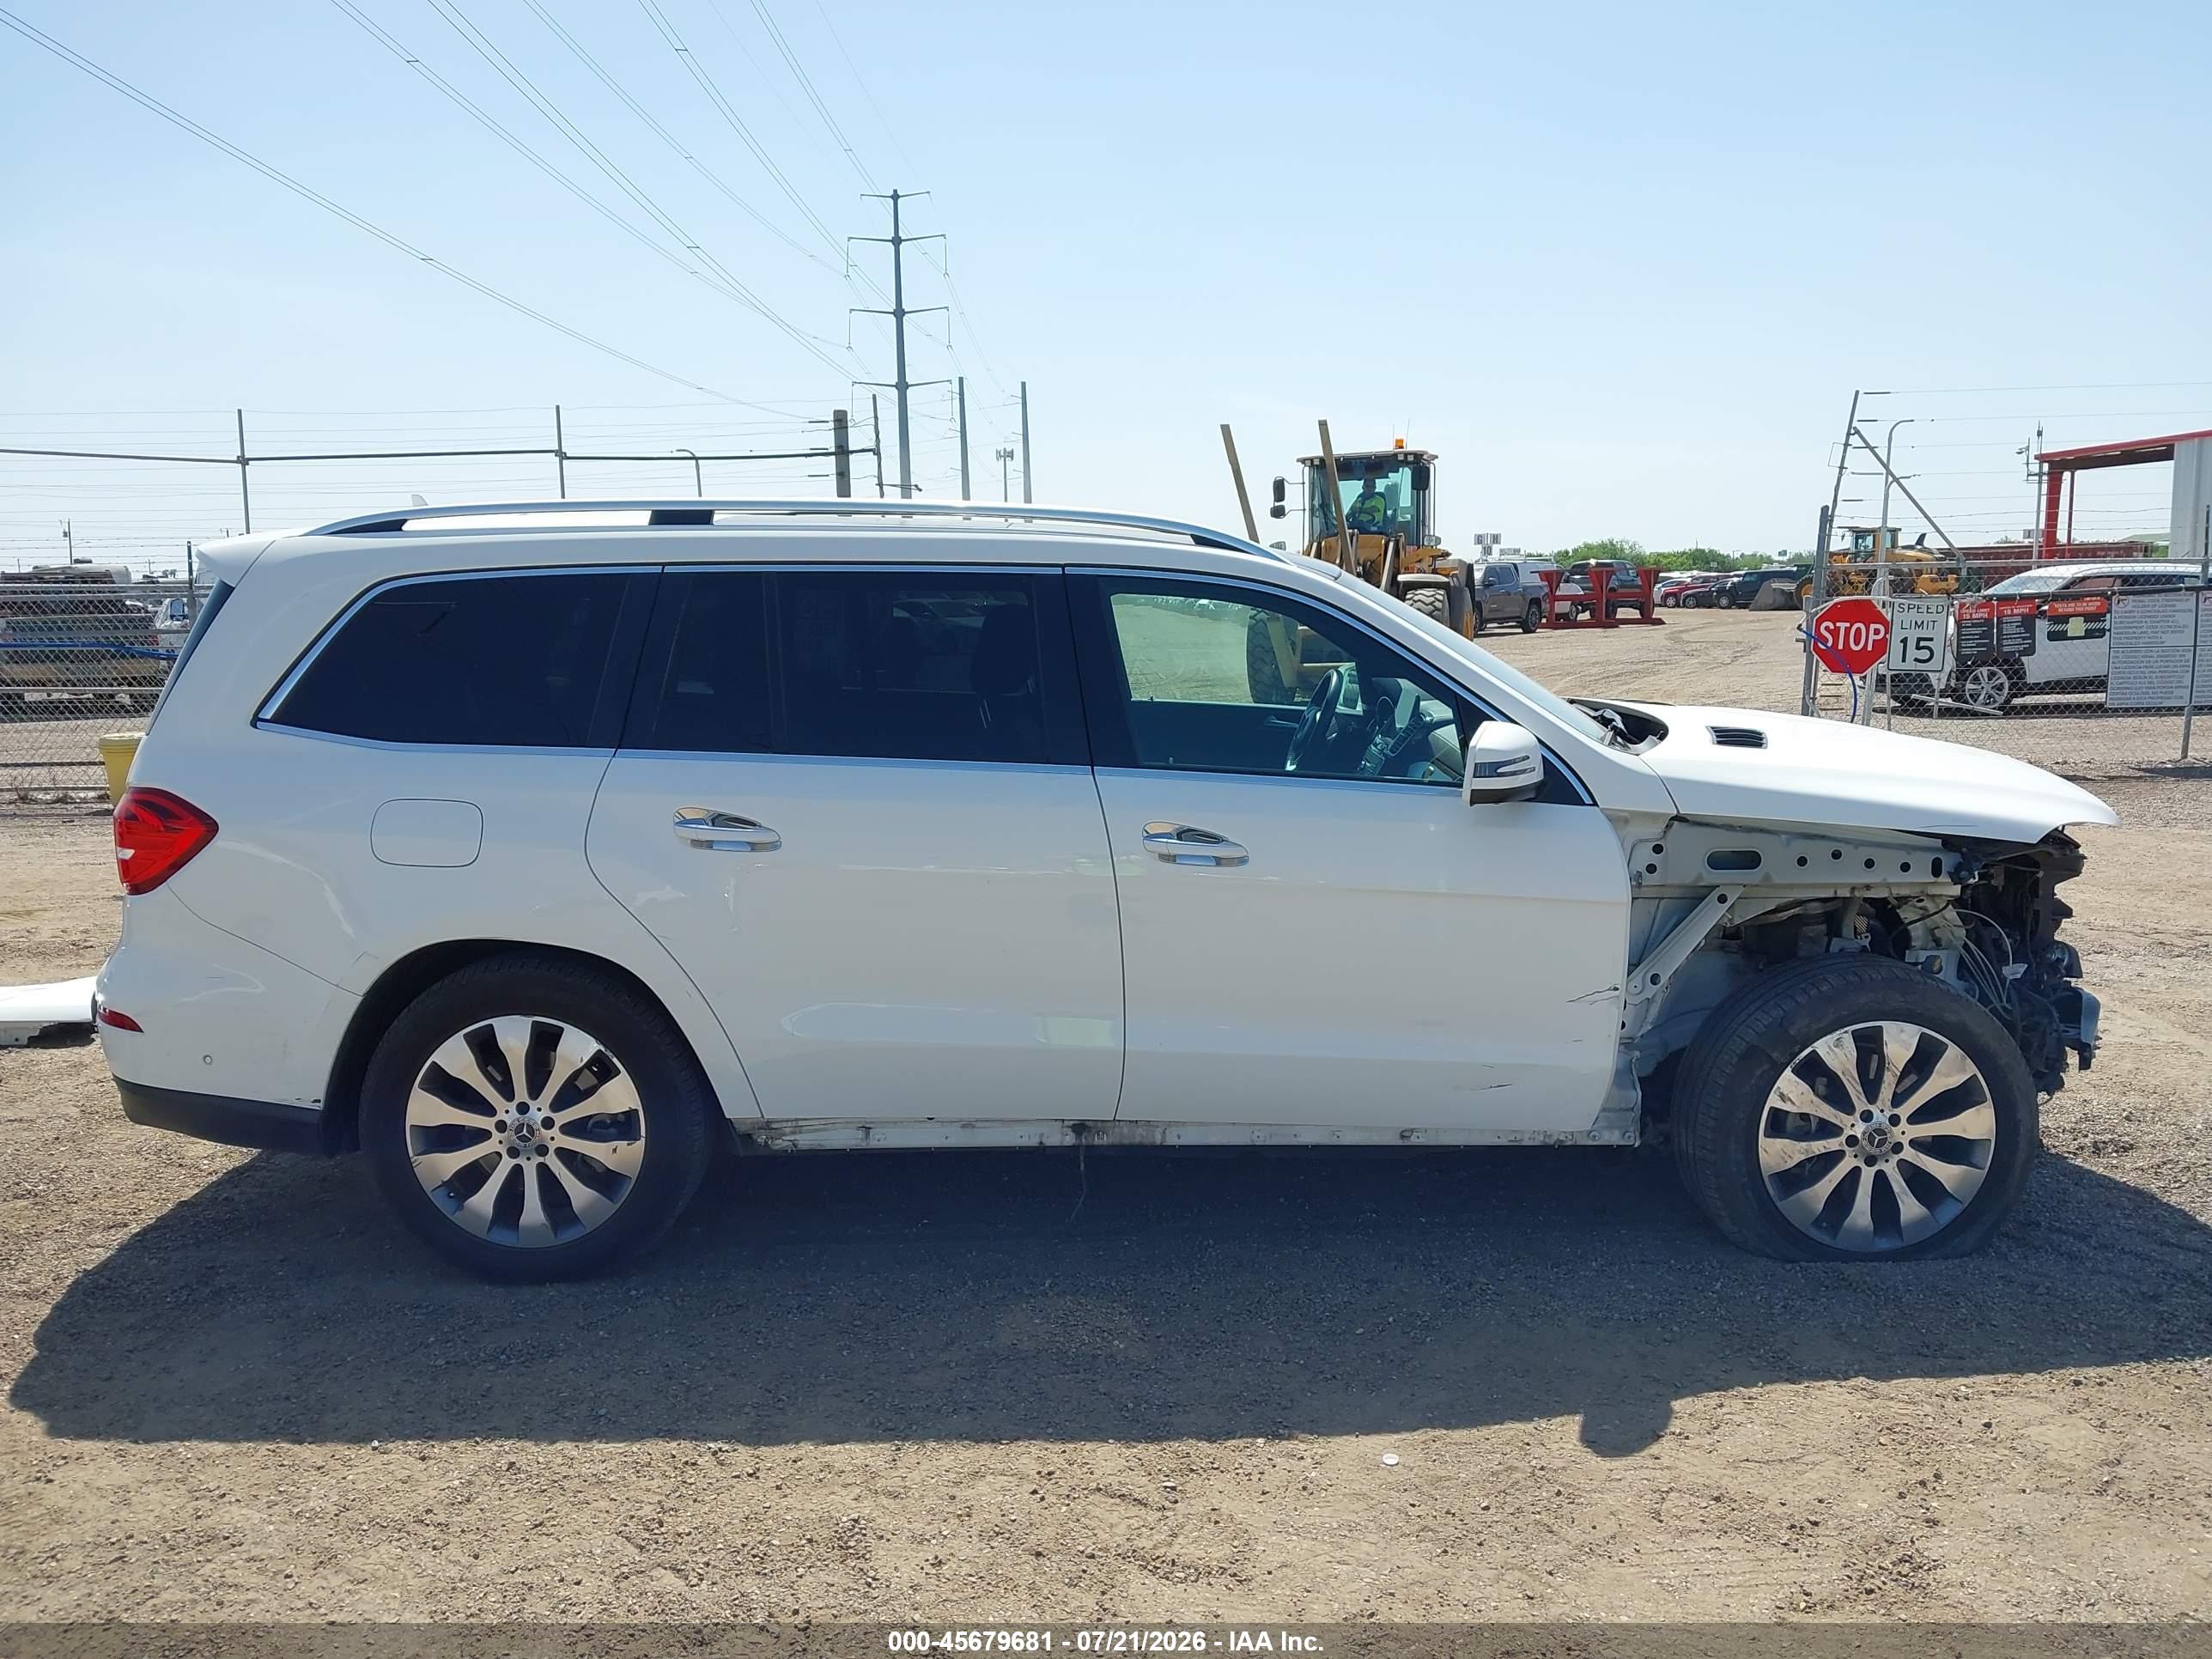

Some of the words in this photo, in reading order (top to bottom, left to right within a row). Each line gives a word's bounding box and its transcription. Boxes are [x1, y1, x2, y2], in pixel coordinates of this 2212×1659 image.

[1483, 545, 1492, 556] 10
[1897, 603, 1945, 614] SPEED
[1900, 619, 1938, 631] LIMIT
[1817, 621, 1886, 652] STOP
[1899, 635, 1936, 664] 15
